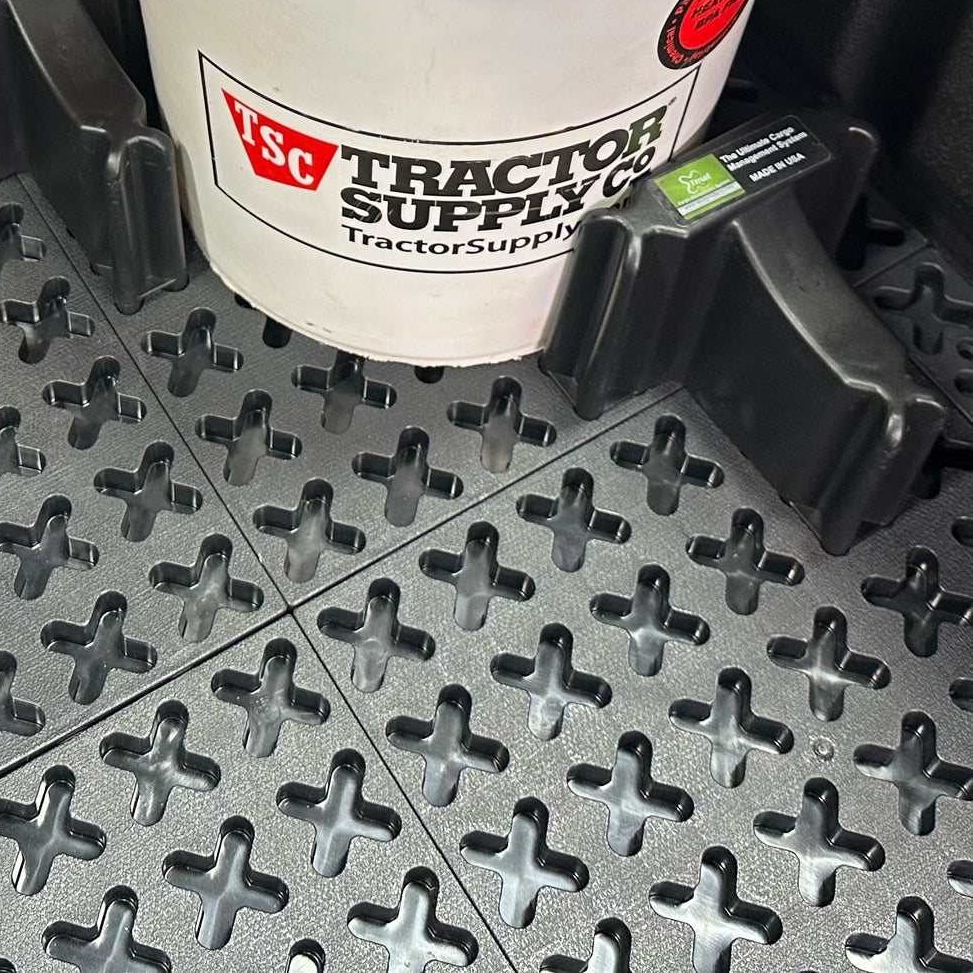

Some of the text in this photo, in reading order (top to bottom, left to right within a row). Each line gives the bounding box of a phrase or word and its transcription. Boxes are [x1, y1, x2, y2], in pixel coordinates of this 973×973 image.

[694, 9, 720, 30] BPA
[664, 26, 685, 64] Chemical
[233, 100, 315, 186] TSC
[340, 104, 668, 197] TRACTOR
[719, 126, 794, 163] The Ultimate Cargo
[726, 131, 808, 172] Management System
[749, 152, 806, 182] MADE IN USA
[340, 173, 601, 233] SUPPLY
